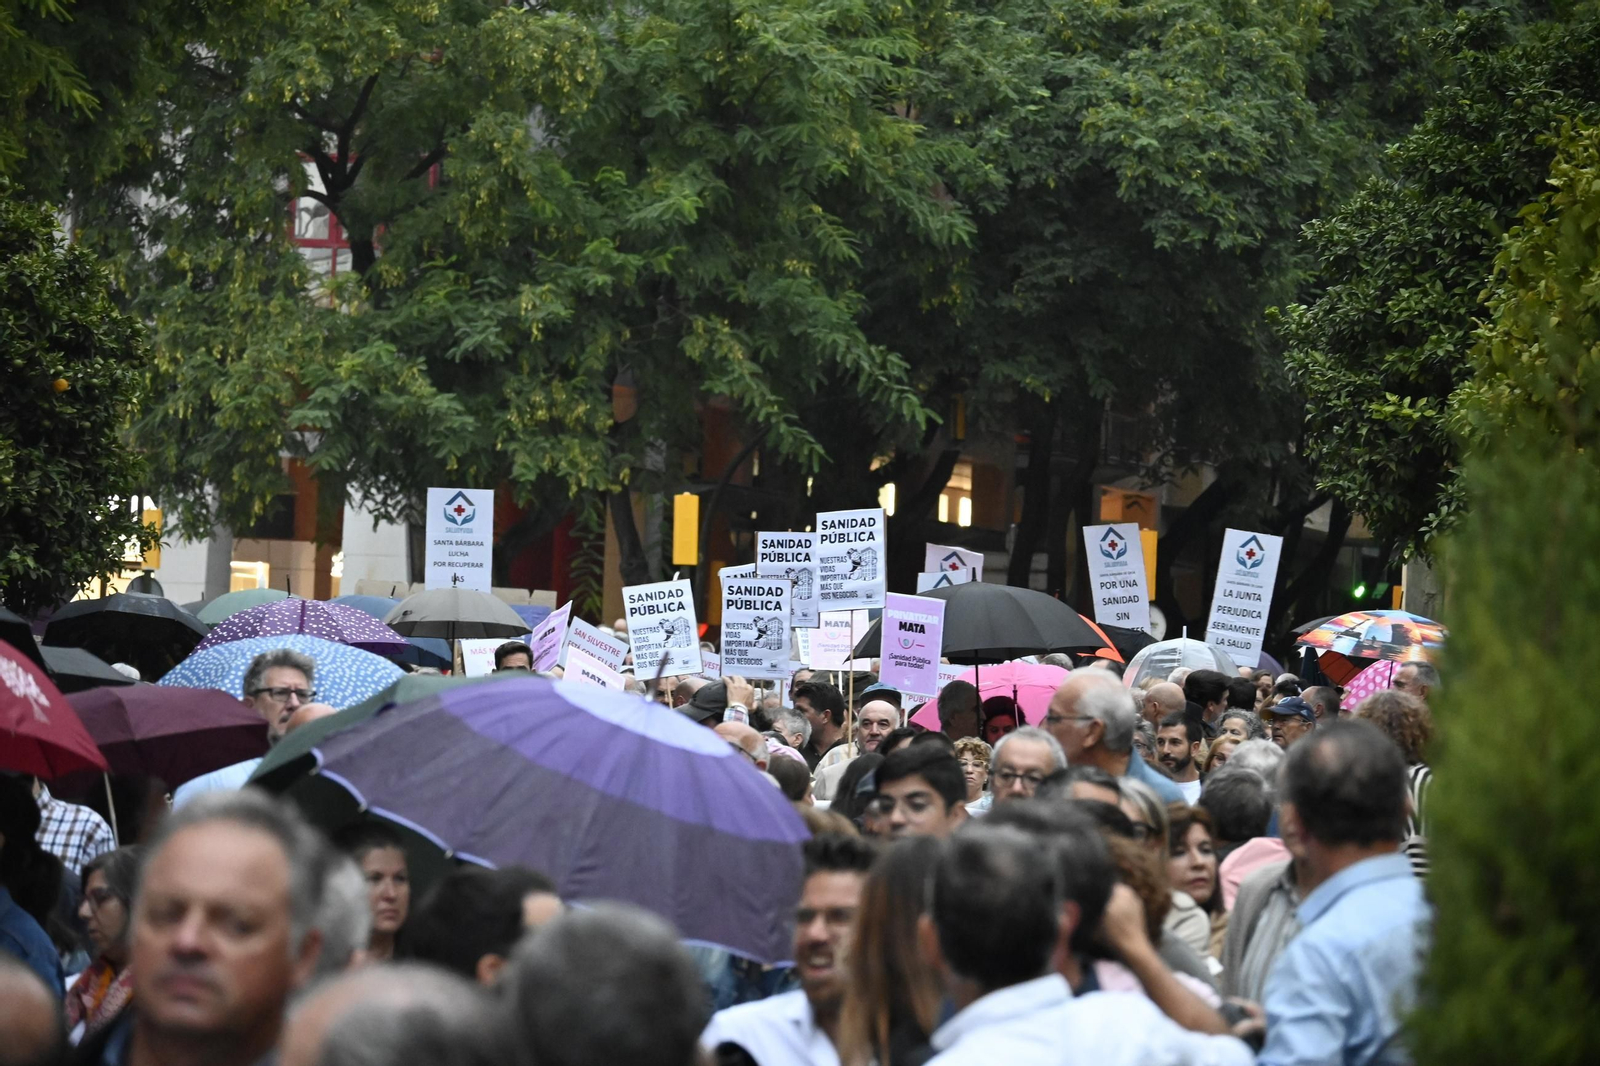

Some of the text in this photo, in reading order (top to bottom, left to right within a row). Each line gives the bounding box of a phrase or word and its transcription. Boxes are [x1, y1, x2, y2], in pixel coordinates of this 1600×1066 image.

[821, 517, 876, 530] SANIDAD
[762, 539, 812, 549] SANIDAD
[820, 531, 876, 544] PÚBLICA
[761, 551, 811, 563] PÚBLICA
[820, 556, 847, 564] NUESTRAS
[1119, 580, 1138, 588] UNA
[629, 588, 684, 604] SANIDAD
[728, 585, 783, 597] SANIDAD
[832, 591, 858, 599] NEGOCIOS
[1223, 589, 1262, 602] LA JUNTA
[726, 598, 782, 611] PÚBLICA
[1102, 595, 1139, 606] SANIDAD
[630, 601, 686, 617] PÚBLICA
[1217, 605, 1262, 619] PERJUDICA
[887, 609, 939, 625] PRIVATIZAR
[1116, 612, 1130, 620] SIN
[632, 626, 660, 636] NUESTRAS
[899, 621, 926, 634] MATA
[1212, 621, 1260, 636] SERIAMENTE
[574, 628, 621, 657] SAN SILVESTRE
[634, 636, 650, 644] VIDAS
[1216, 637, 1252, 650] LA SALUD
[635, 643, 662, 652] IMPORTAN
[889, 653, 931, 665] ¡Sanidad Pública
[582, 669, 607, 687] MATA
